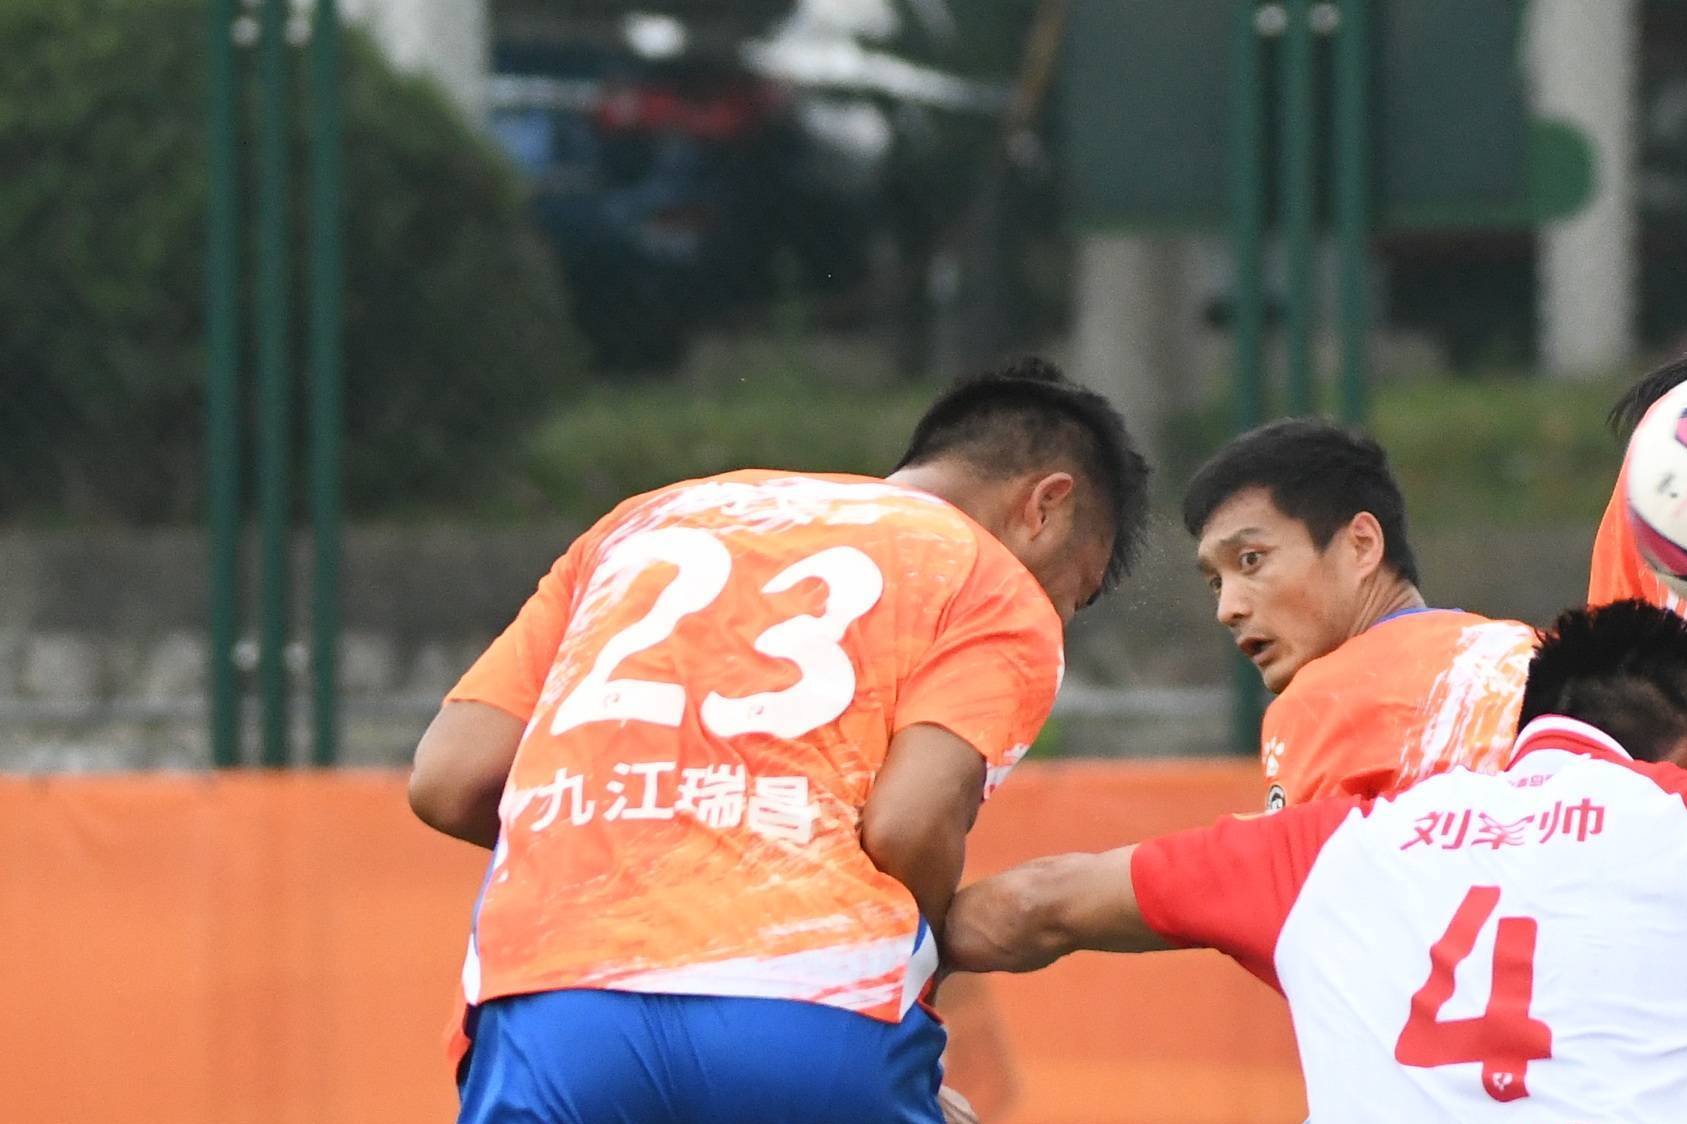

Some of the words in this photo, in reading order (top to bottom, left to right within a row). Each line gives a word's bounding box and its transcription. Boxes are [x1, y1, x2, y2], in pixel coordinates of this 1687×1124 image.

[550, 527, 883, 741] 23
[530, 761, 813, 844] 九江瑞昌
[1395, 886, 1552, 1102] 4
